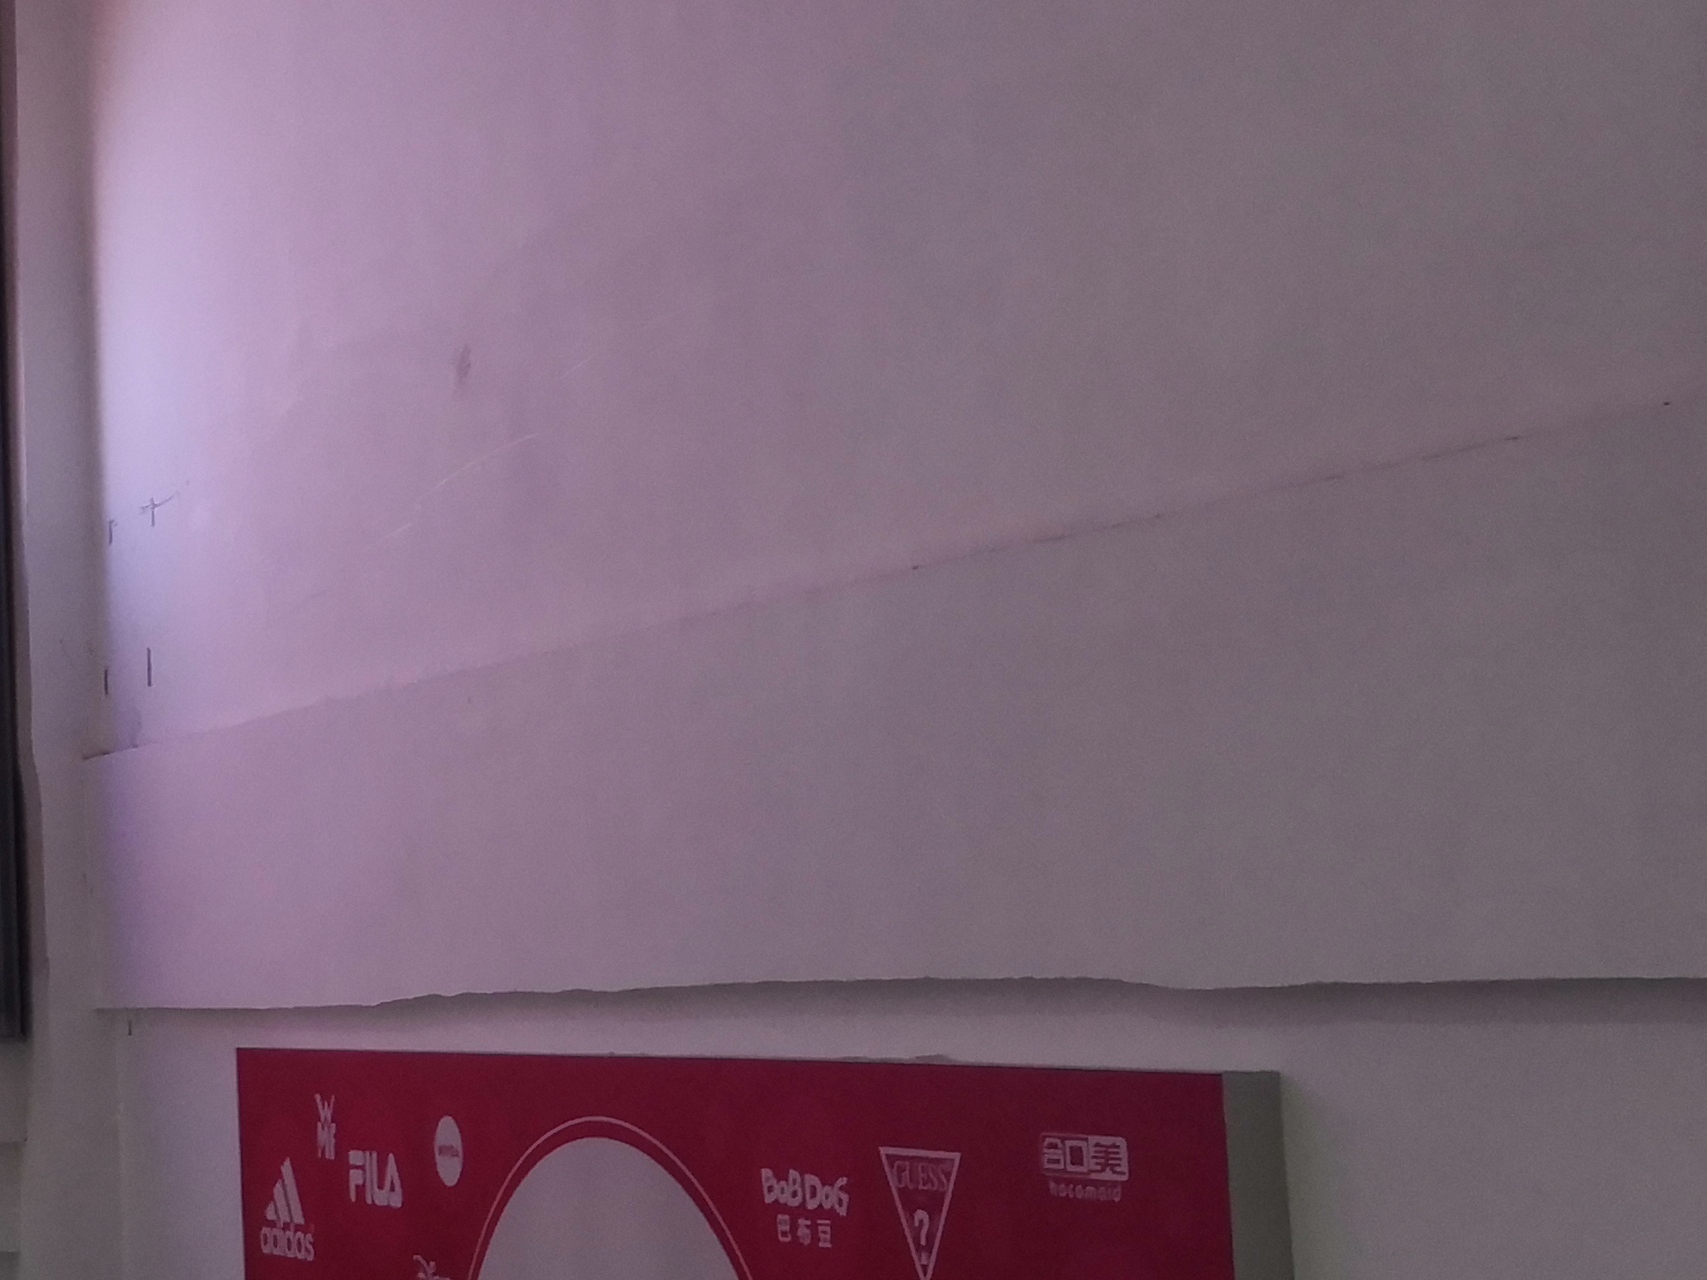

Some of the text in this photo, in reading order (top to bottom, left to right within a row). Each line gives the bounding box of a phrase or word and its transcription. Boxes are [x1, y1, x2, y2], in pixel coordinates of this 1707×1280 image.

[348, 1149, 404, 1209] FILA
[891, 1159, 950, 1193] GUESS
[259, 1223, 316, 1262] adidas
[776, 1213, 834, 1249] 巴布豆
